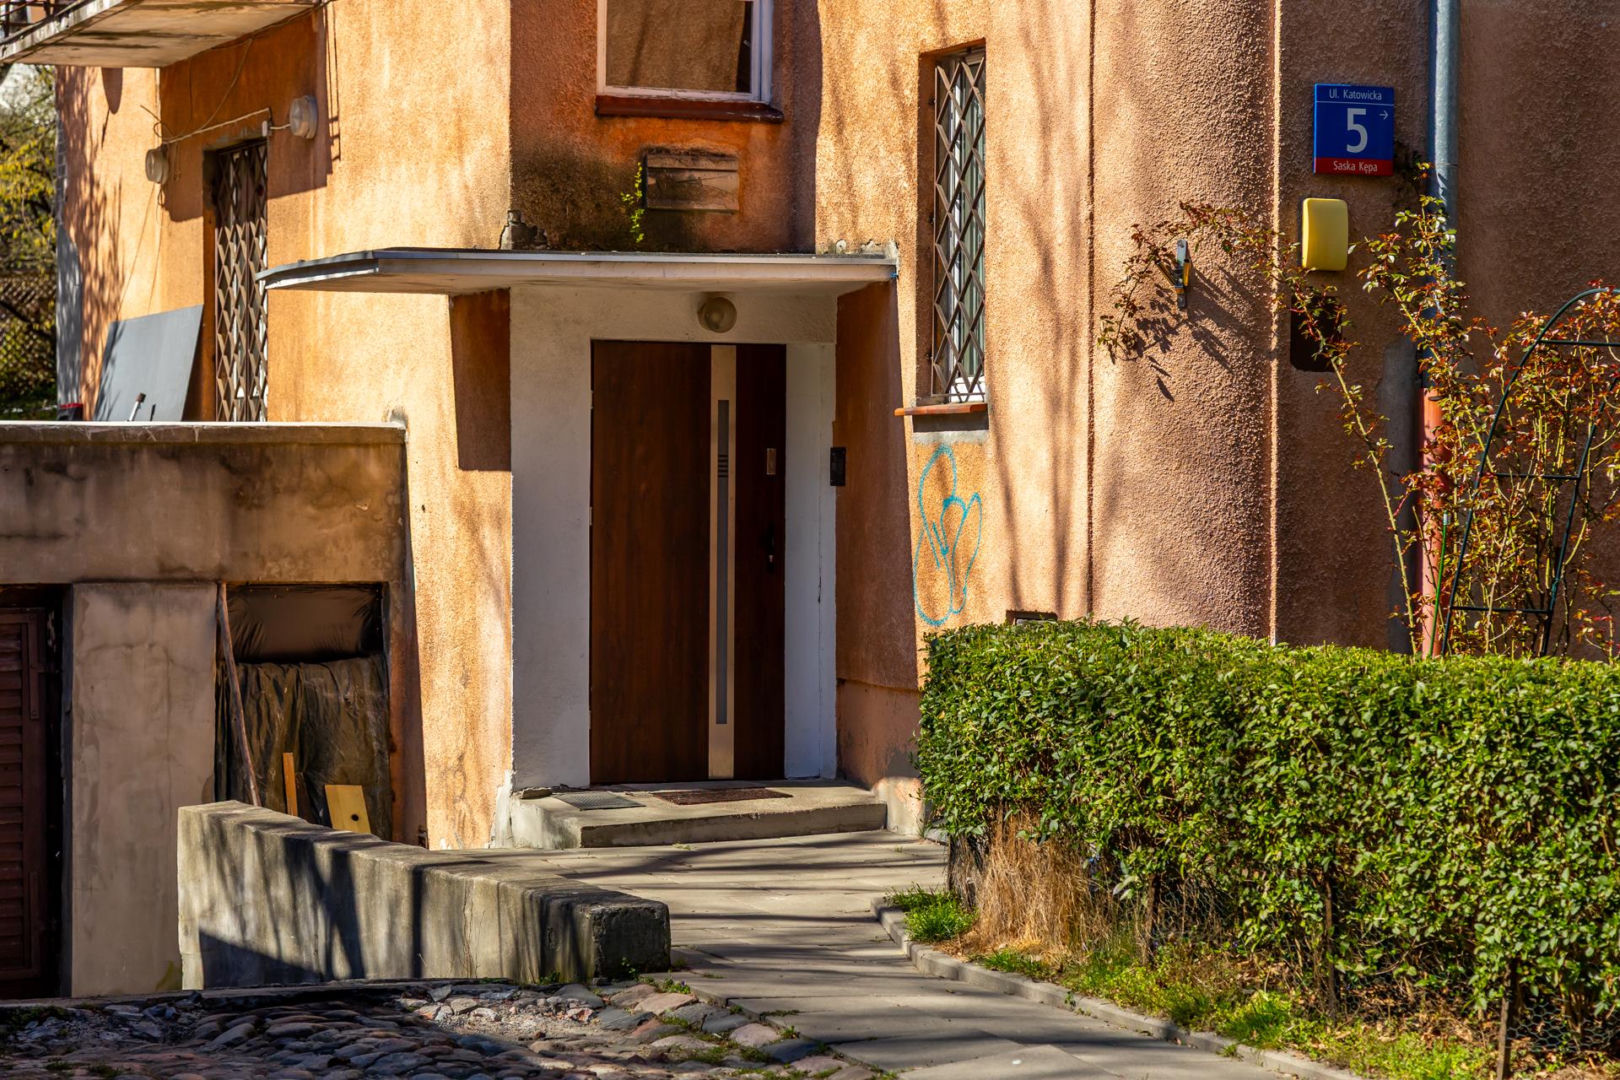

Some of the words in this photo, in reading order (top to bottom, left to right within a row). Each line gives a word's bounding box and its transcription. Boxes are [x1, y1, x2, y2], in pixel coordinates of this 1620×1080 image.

[1329, 88, 1340, 99] Ul.
[1343, 89, 1382, 101] Katowicka
[1346, 107, 1368, 153] 5
[1333, 160, 1355, 171] Saska
[1359, 162, 1378, 174] Kępa
